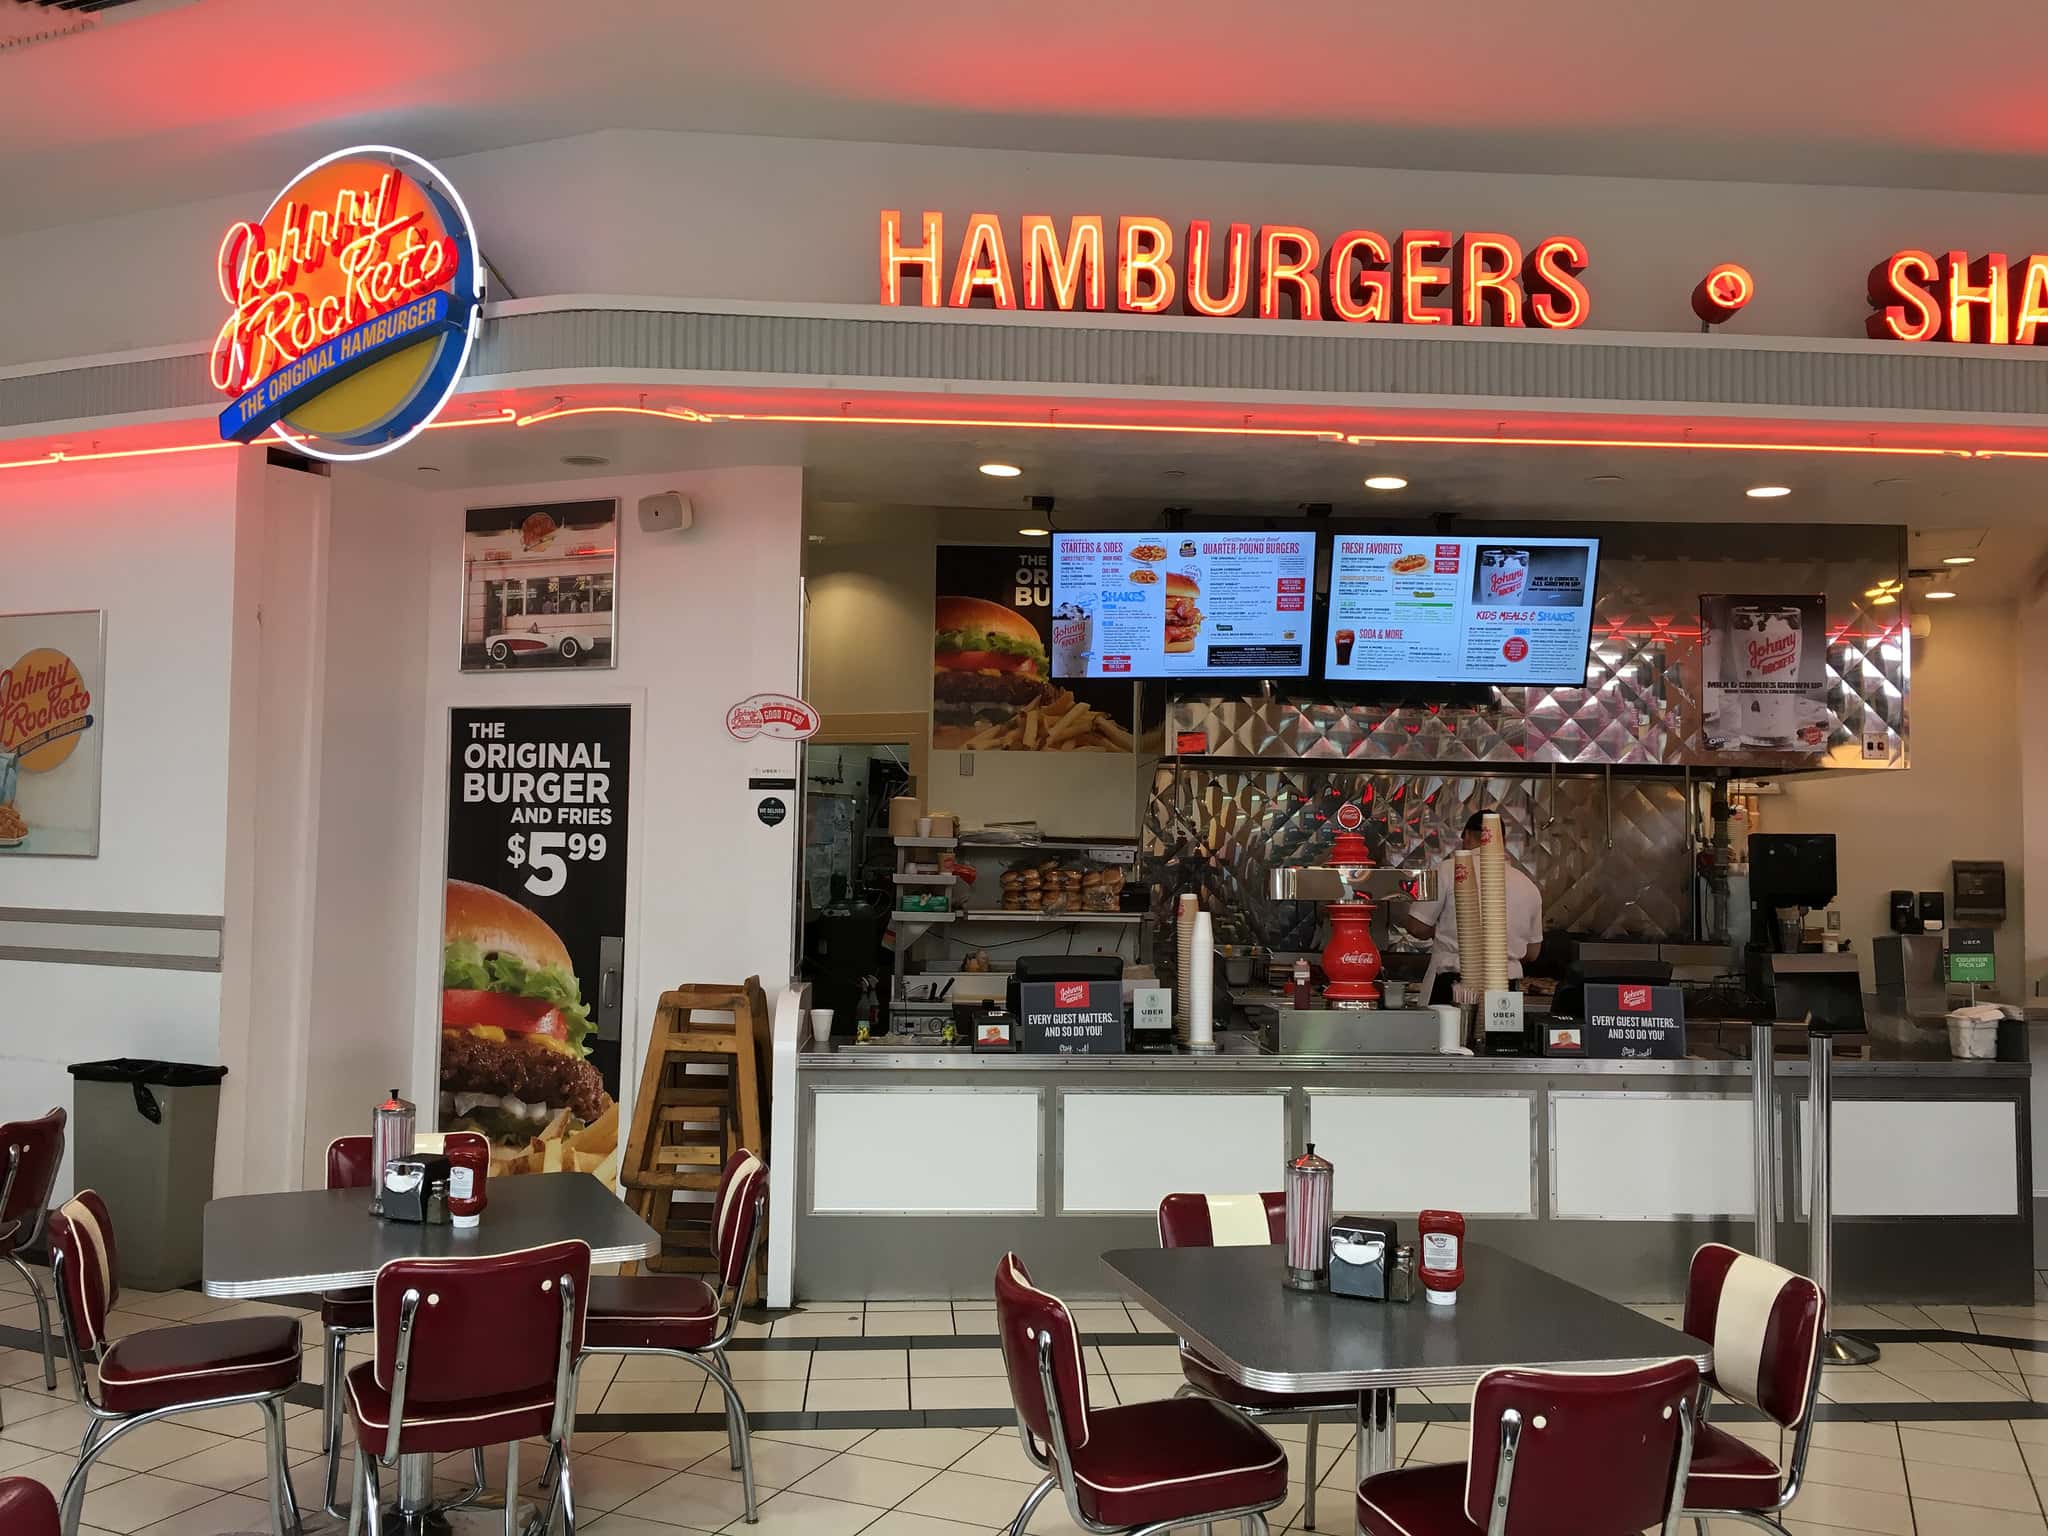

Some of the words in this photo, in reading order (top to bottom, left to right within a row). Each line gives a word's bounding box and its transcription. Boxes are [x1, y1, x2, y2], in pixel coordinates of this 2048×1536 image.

[213, 172, 410, 350] Johnny
[880, 210, 1591, 328] HAMBURGERS
[241, 227, 443, 391] Rockets
[239, 387, 266, 423] THE
[269, 353, 336, 401] ORIGINAL
[340, 297, 437, 360] HAMBURGER
[1061, 542, 1095, 553] STARTERS
[1096, 543, 1102, 553] &
[1104, 542, 1123, 553] SIDES
[1203, 543, 1264, 554] QUARTER-POUND
[1266, 542, 1300, 554] BURGERS
[1341, 542, 1364, 554] FRESH
[1366, 543, 1403, 554] FAVORITES
[1018, 555, 1047, 566] THE
[1490, 568, 1524, 589] Johnny
[1101, 590, 1146, 602] SHAKES
[1476, 610, 1497, 621] KIDS
[1499, 611, 1529, 622] MEALS
[1537, 611, 1575, 622] SHAKES
[1054, 623, 1086, 640] Johnny
[1359, 628, 1376, 639] SODA
[1376, 629, 1383, 639] &
[1384, 629, 1404, 640] MORE
[1748, 632, 1796, 663] Johnny
[0, 657, 77, 725] Johnny
[1739, 681, 1776, 689] COOKIES
[6, 685, 91, 746] Rockets
[764, 709, 781, 721] GOOD
[783, 710, 792, 718] TO
[469, 722, 505, 738] THE
[464, 742, 611, 769] ORIGINAL
[463, 772, 610, 804] BURGER
[510, 807, 553, 824] AND
[558, 807, 612, 825] FRIES
[1341, 951, 1374, 965] Coca-Cola
[1060, 984, 1083, 999] Johnny
[1624, 989, 1646, 1003] Johnny
[1028, 1014, 1053, 1025] EVERY
[1053, 1014, 1077, 1024] GUEST
[1591, 1015, 1616, 1026] EVERY
[1616, 1015, 1640, 1027] GUEST
[1044, 1026, 1060, 1037] AND
[1061, 1026, 1072, 1037] SO
[1073, 1026, 1084, 1036] DO
[1085, 1025, 1103, 1036] YOU!
[1608, 1028, 1624, 1039] AND
[1625, 1029, 1635, 1039] SO
[1636, 1029, 1647, 1040] DO
[1648, 1030, 1665, 1041] YOU!
